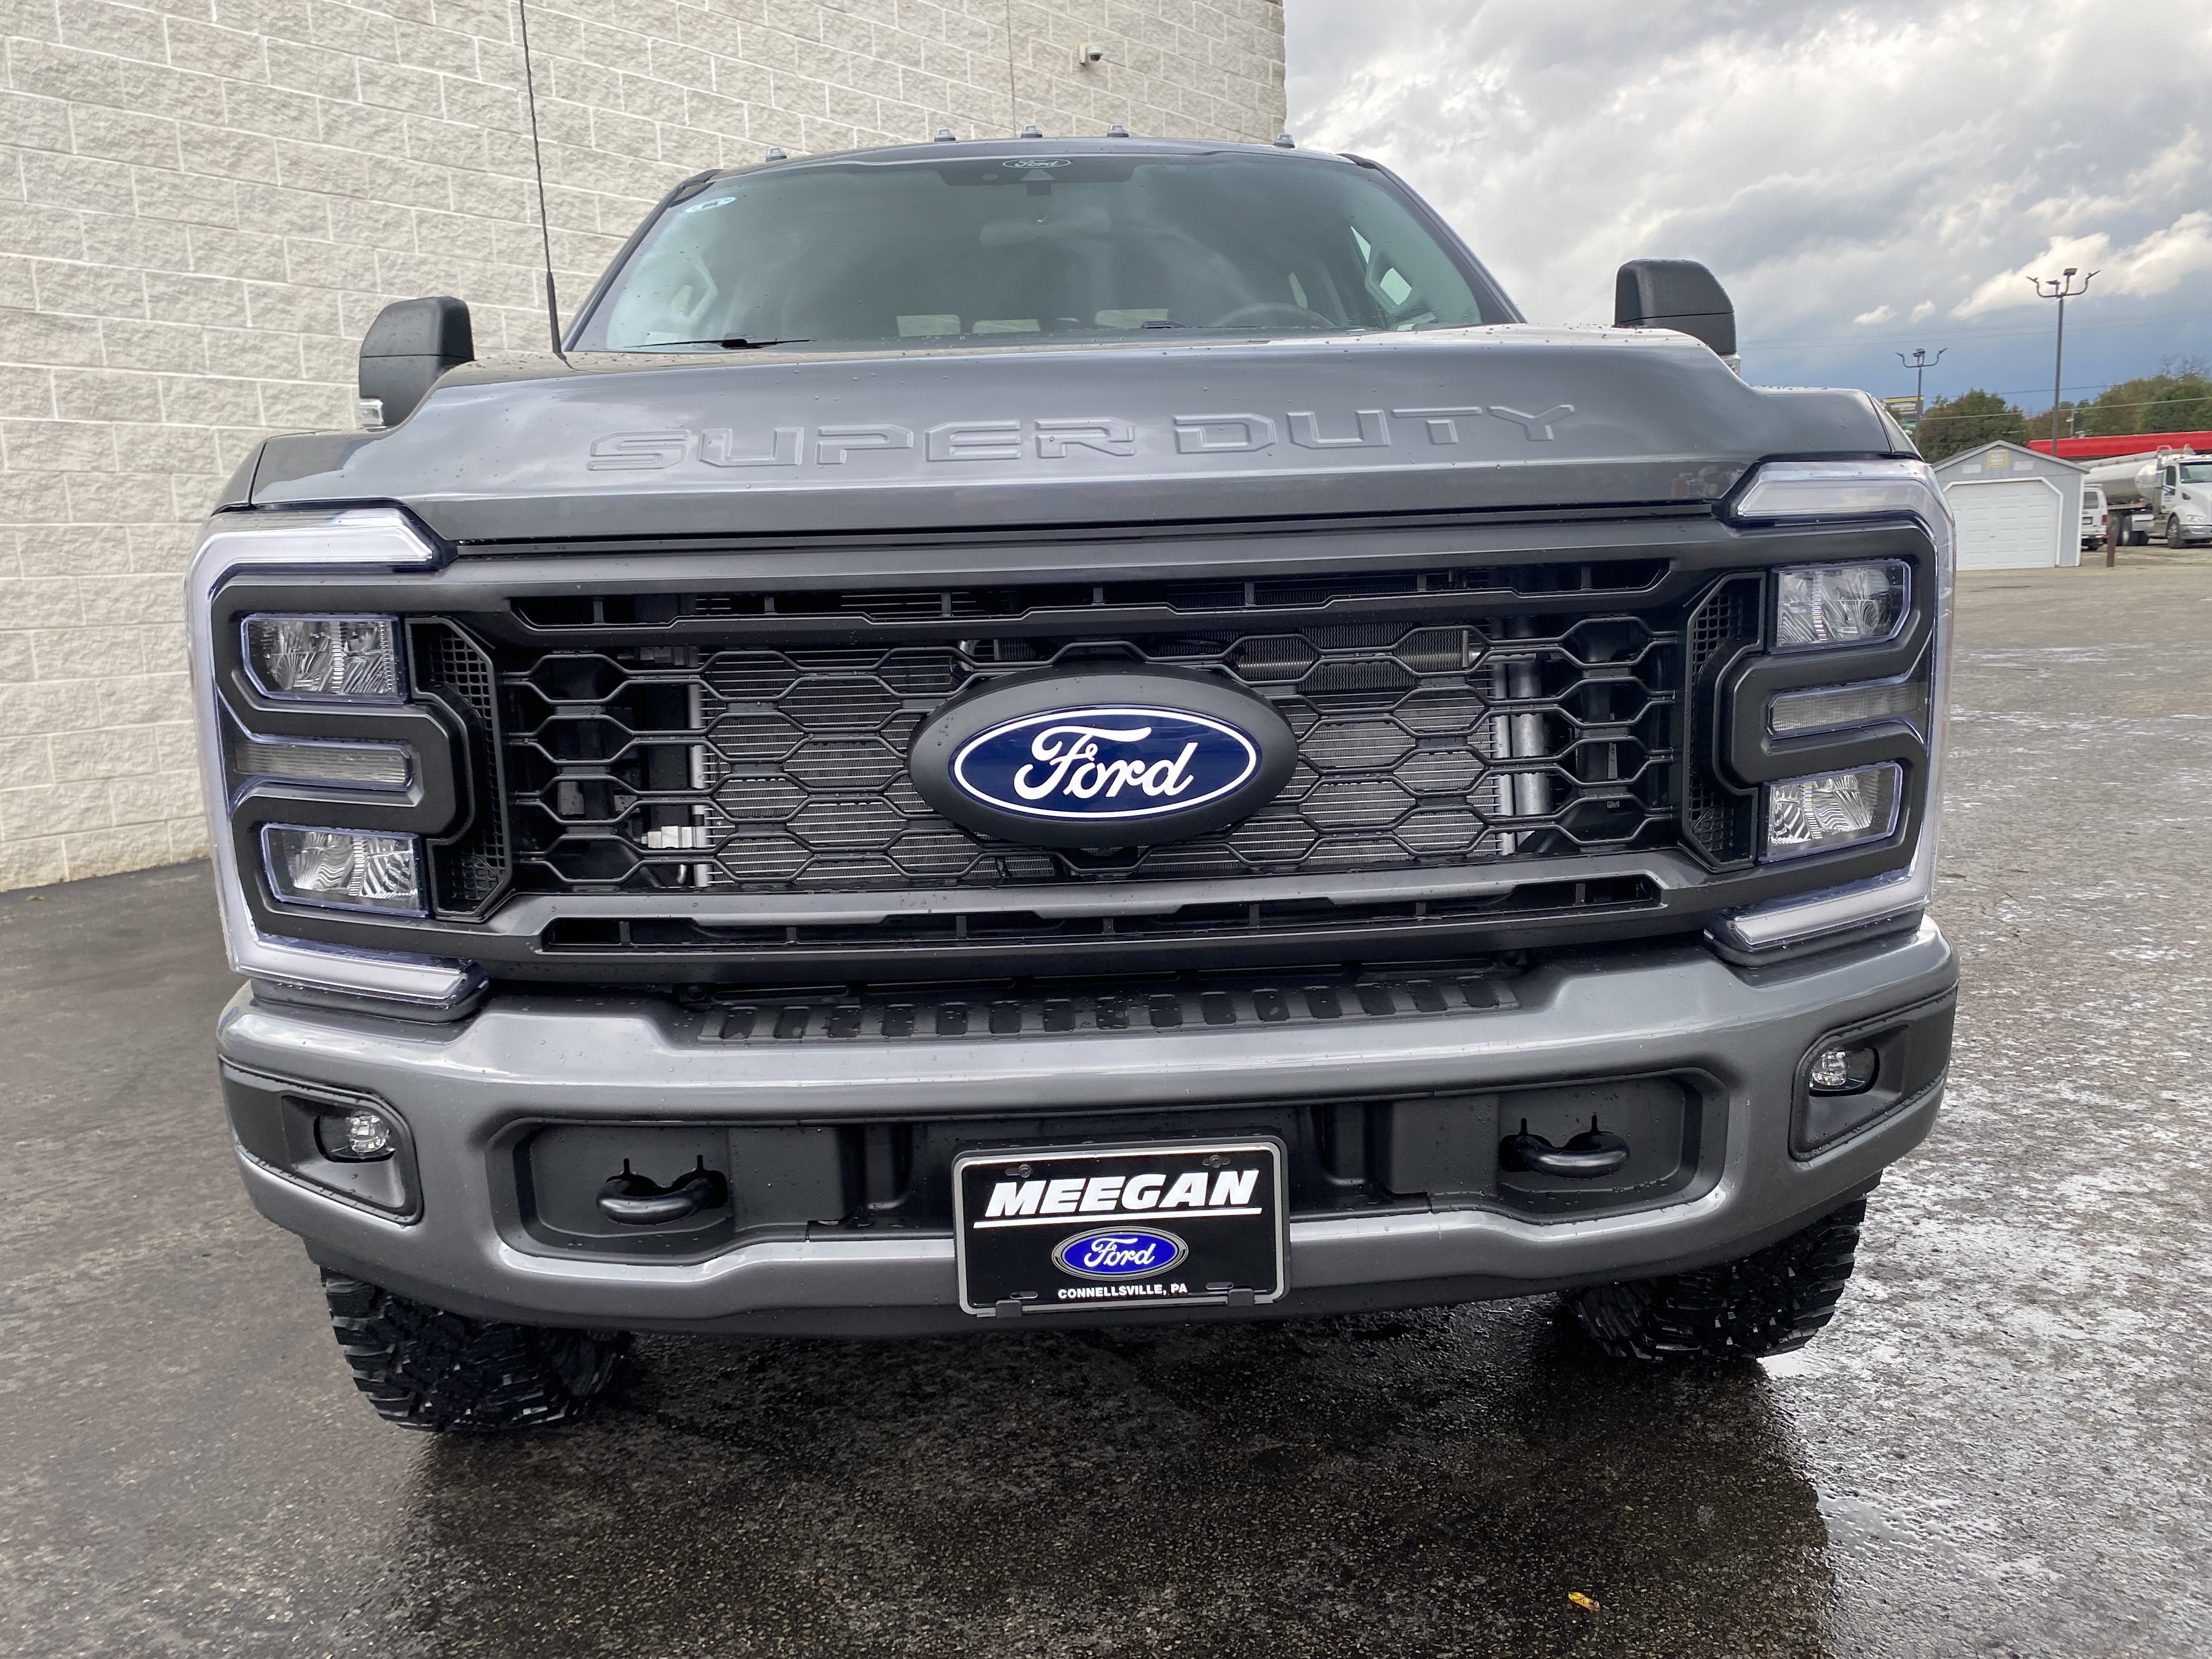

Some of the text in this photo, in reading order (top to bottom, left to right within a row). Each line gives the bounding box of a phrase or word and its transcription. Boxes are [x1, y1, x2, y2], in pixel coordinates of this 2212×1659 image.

[587, 404, 1575, 471] SUPER DUTY
[1013, 725, 1199, 799] Ford
[985, 1170, 1259, 1217] MEEGAN
[1084, 1238, 1155, 1267] Ford
[1058, 1283, 1188, 1300] CONNELLSVILLE, PA
